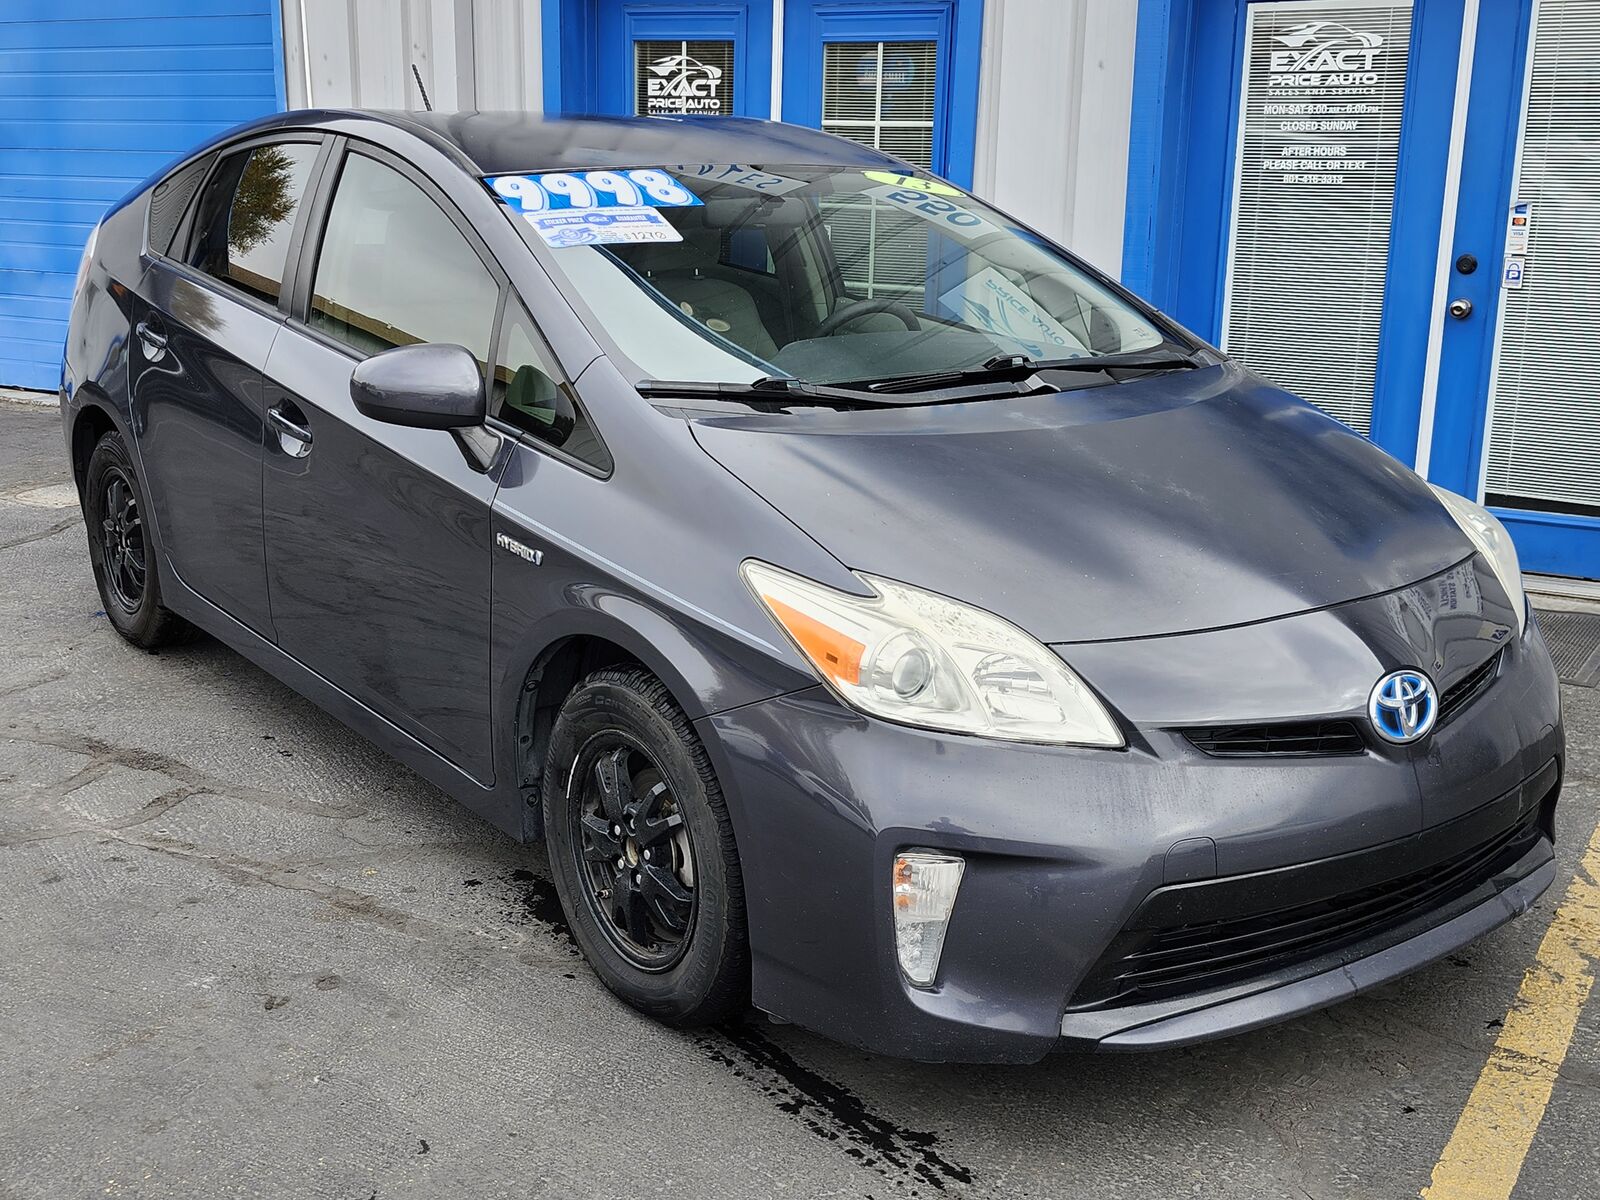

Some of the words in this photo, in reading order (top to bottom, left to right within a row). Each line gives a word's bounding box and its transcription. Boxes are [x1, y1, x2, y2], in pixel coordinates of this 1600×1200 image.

[1269, 49, 1381, 71] EXACT
[1269, 74, 1321, 86] PRICE
[1324, 73, 1378, 85] AUTO
[647, 78, 722, 97] EXACT
[1329, 87, 1376, 95] SERVICE
[647, 98, 683, 108] PRICE
[686, 98, 721, 109] AUTO
[1280, 121, 1318, 131] CLOSED
[1320, 119, 1359, 131] SUNDAY
[1281, 147, 1312, 156] AFTER
[1314, 147, 1347, 156] HOURS
[1262, 160, 1298, 170] PLEASE
[493, 169, 692, 211] 9998
